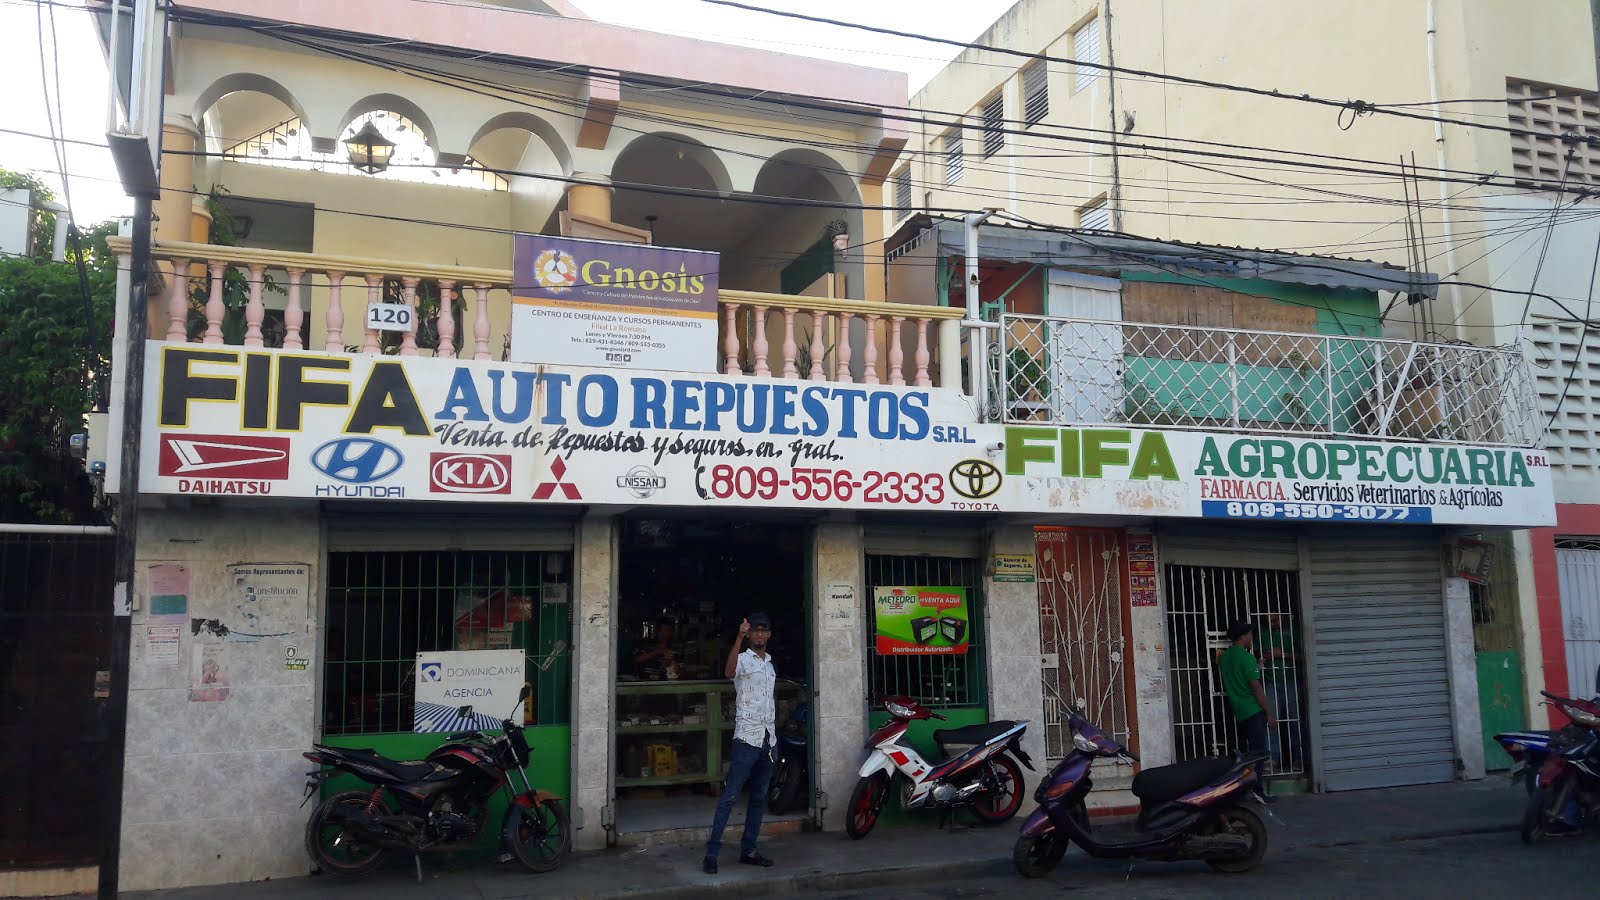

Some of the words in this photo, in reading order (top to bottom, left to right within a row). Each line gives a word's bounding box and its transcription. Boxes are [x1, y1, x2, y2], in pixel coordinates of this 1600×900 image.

[581, 259, 705, 295] Gnosis
[370, 307, 410, 325] 120
[531, 309, 562, 318] CENTRO
[562, 311, 573, 319] DE
[573, 312, 618, 322] ENSEÑANZA
[618, 315, 623, 323] Y
[623, 316, 651, 325] CURSOS
[652, 318, 702, 328] PERMANENTES
[591, 322, 608, 331] Filial
[609, 323, 617, 331] La
[618, 324, 647, 333] Romana
[158, 346, 435, 437] FIFA
[434, 367, 618, 427] AUTO
[630, 377, 930, 441] REPUESTOS
[433, 420, 507, 447] Venta
[510, 425, 543, 448] de
[544, 425, 647, 460] Repuestos
[651, 435, 669, 466] y
[1005, 426, 1180, 481] FIFA
[1194, 436, 1535, 487] AGROPECUARIA
[441, 461, 499, 486] KIA
[625, 477, 659, 488] NISSAN
[178, 480, 272, 494] DAIHATSU
[315, 484, 405, 498] HYUNDAI
[711, 464, 945, 504] 809-556-2333
[1293, 481, 1354, 504] Servicios
[1355, 483, 1436, 506] Veterinarios
[951, 501, 999, 511] TOYOTA
[1226, 501, 1410, 520] 809-550-3077
[253, 568, 296, 576] Representantes
[878, 595, 916, 605] METEORO
[447, 666, 521, 678] DOMINICANA
[443, 687, 493, 698] AGENCIA
